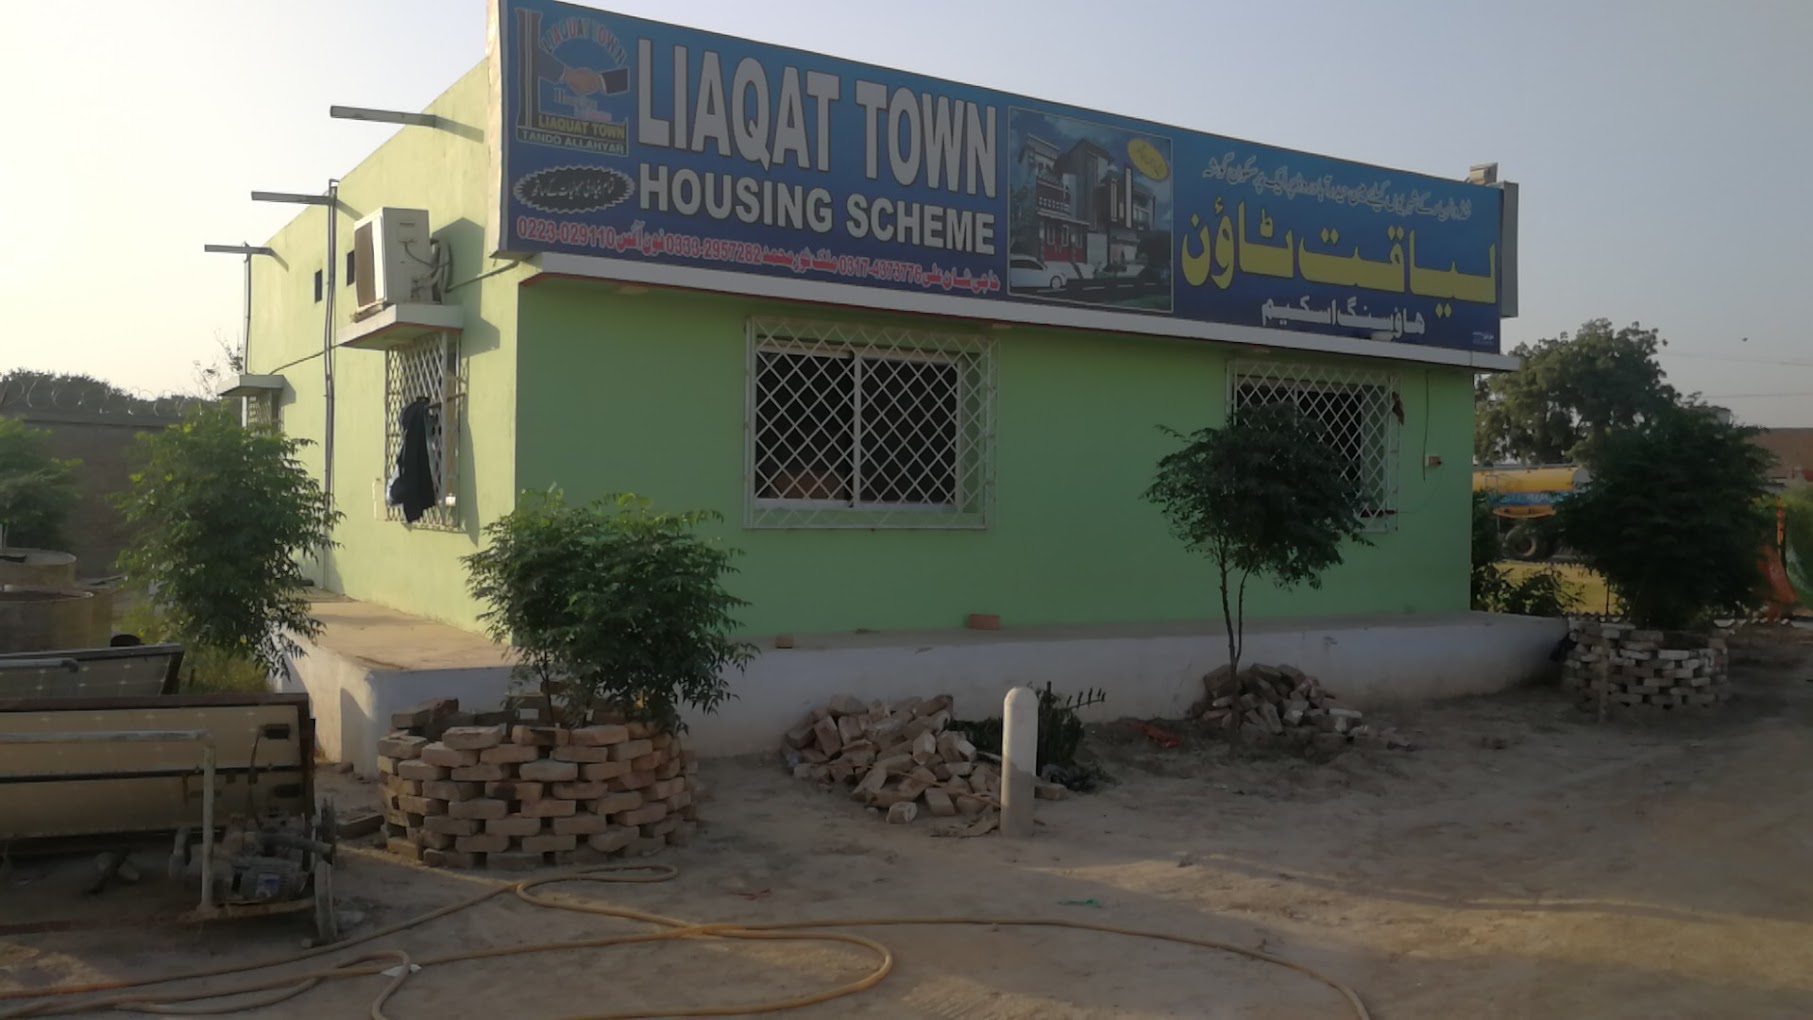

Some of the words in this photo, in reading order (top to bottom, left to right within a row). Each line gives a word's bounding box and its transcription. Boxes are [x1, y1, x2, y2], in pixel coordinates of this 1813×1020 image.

[522, 130, 562, 146] TANDO
[565, 137, 625, 155] ALLAHYAR
[539, 116, 589, 133] LIAQUAT
[593, 124, 625, 139] TOWN
[637, 38, 840, 171] LIAQAT
[856, 79, 998, 198] TOWN
[516, 216, 616, 250] 0223-029110
[639, 163, 834, 233] HOUSING
[846, 193, 997, 256] SCHEME
[665, 232, 763, 265] 0333-2957282
[1181, 197, 1295, 290] ٹاؤن
[1299, 224, 1498, 320] لیاقت
